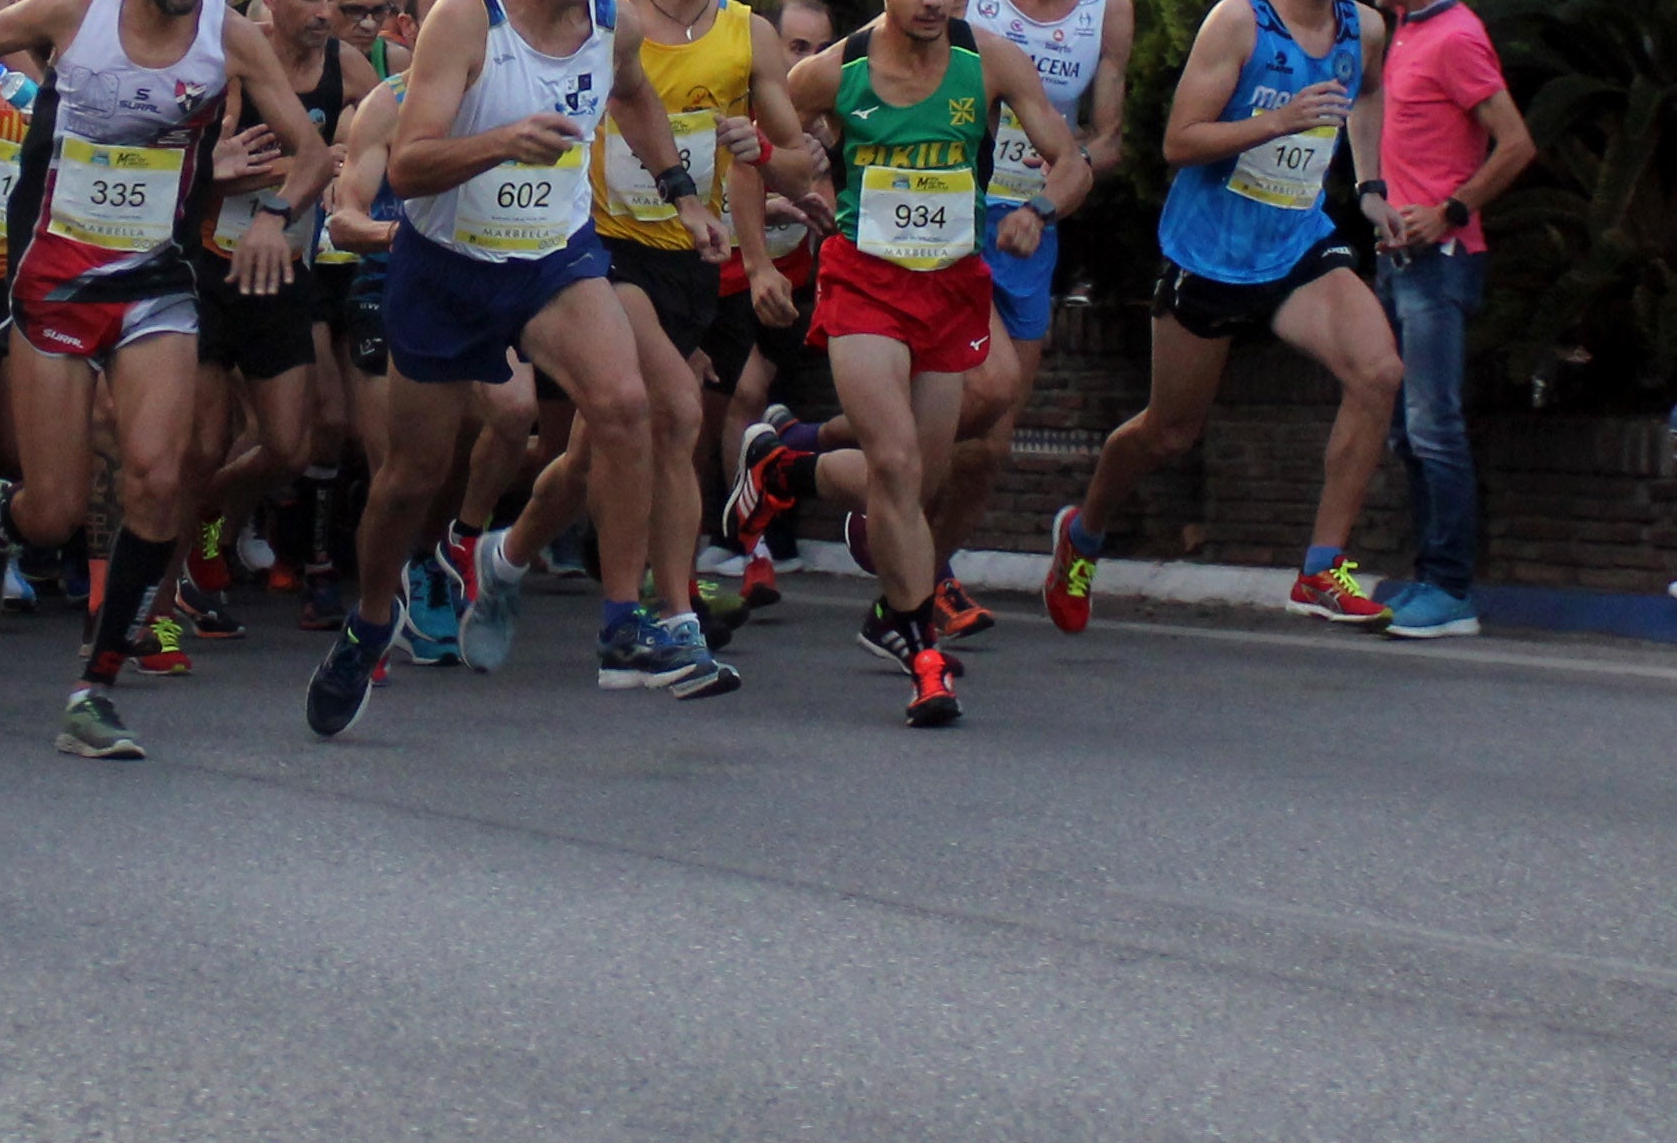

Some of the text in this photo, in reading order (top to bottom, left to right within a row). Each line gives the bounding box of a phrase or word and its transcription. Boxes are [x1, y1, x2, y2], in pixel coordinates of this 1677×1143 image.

[119, 100, 162, 114] SURAL
[1276, 145, 1315, 172] 107
[90, 180, 147, 207] 335
[497, 181, 552, 208] 602
[895, 204, 946, 229] 934
[483, 228, 550, 239] MARBELLA
[883, 248, 950, 257] MARBELLA
[42, 328, 84, 349] SURAL
